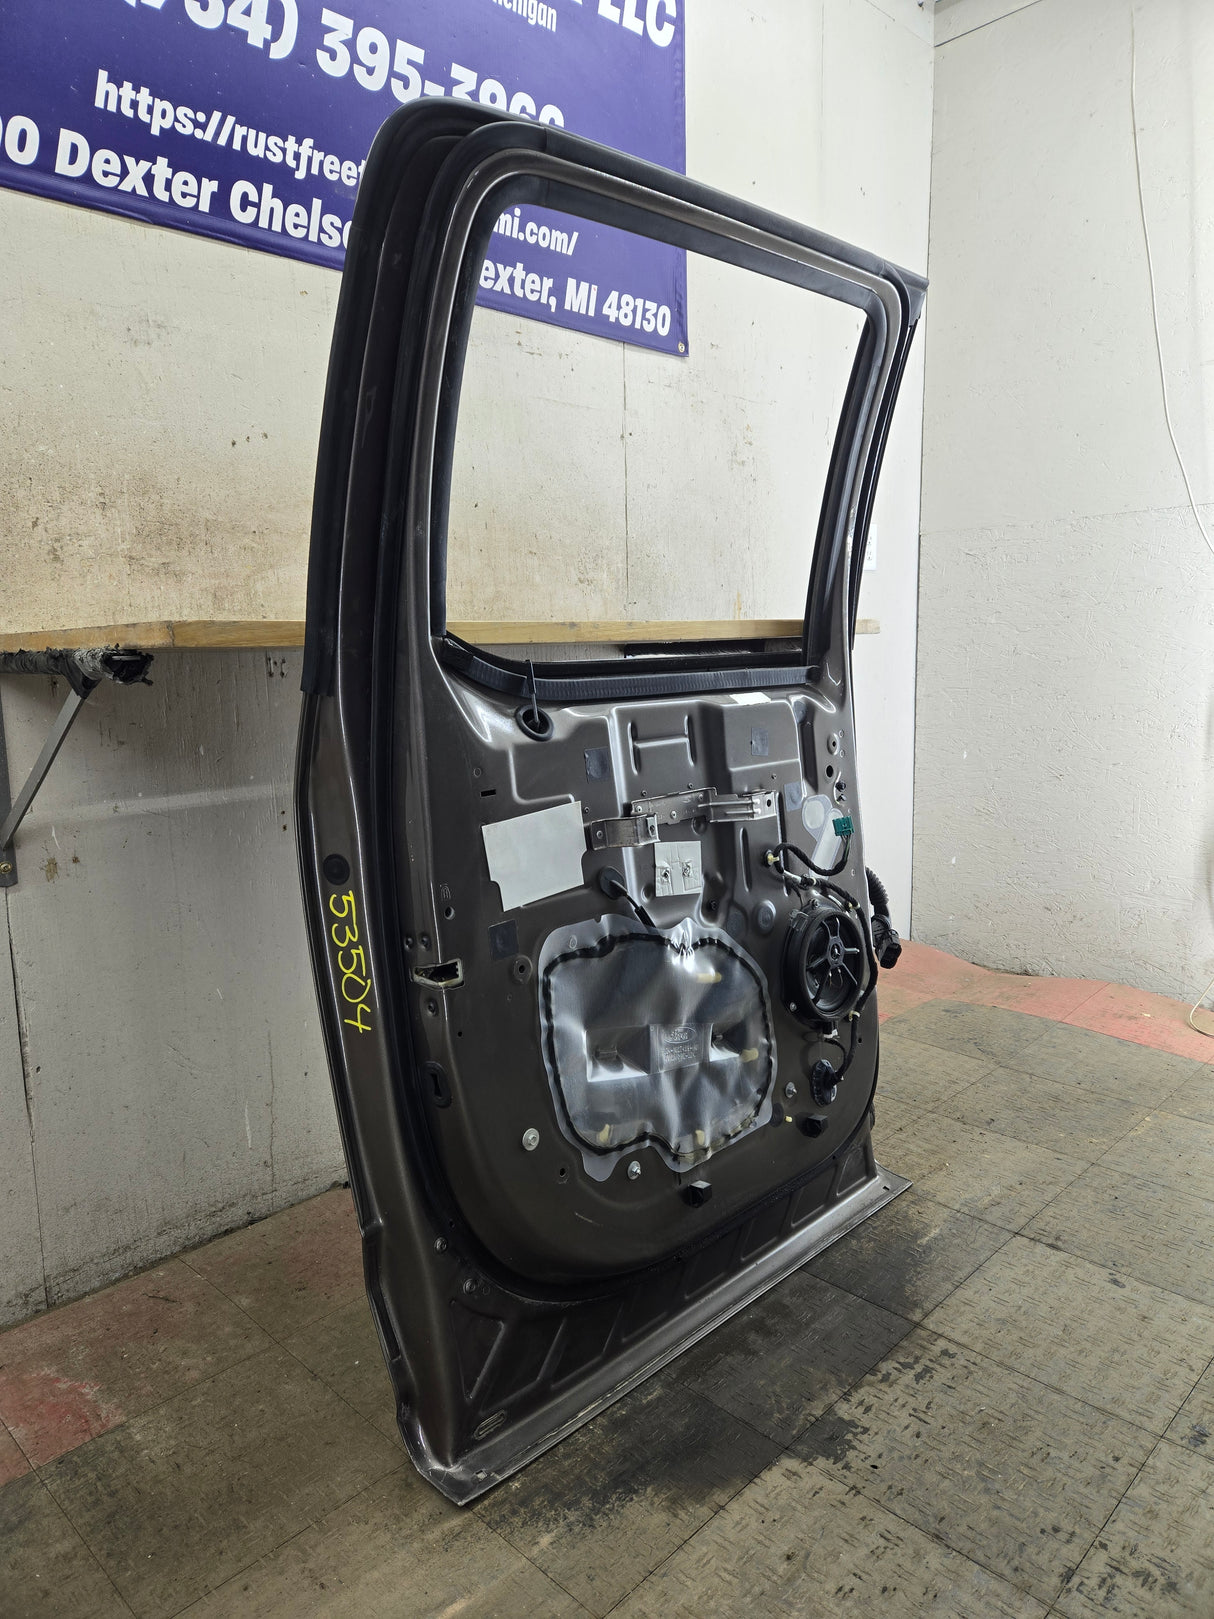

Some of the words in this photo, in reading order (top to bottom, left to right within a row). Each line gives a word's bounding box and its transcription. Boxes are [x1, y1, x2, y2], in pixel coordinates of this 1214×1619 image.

[0, 115, 40, 165] 0
[55, 128, 218, 213] Dexter
[564, 277, 598, 317] MI
[602, 290, 672, 337] 48130
[329, 890, 372, 1033] 53504
